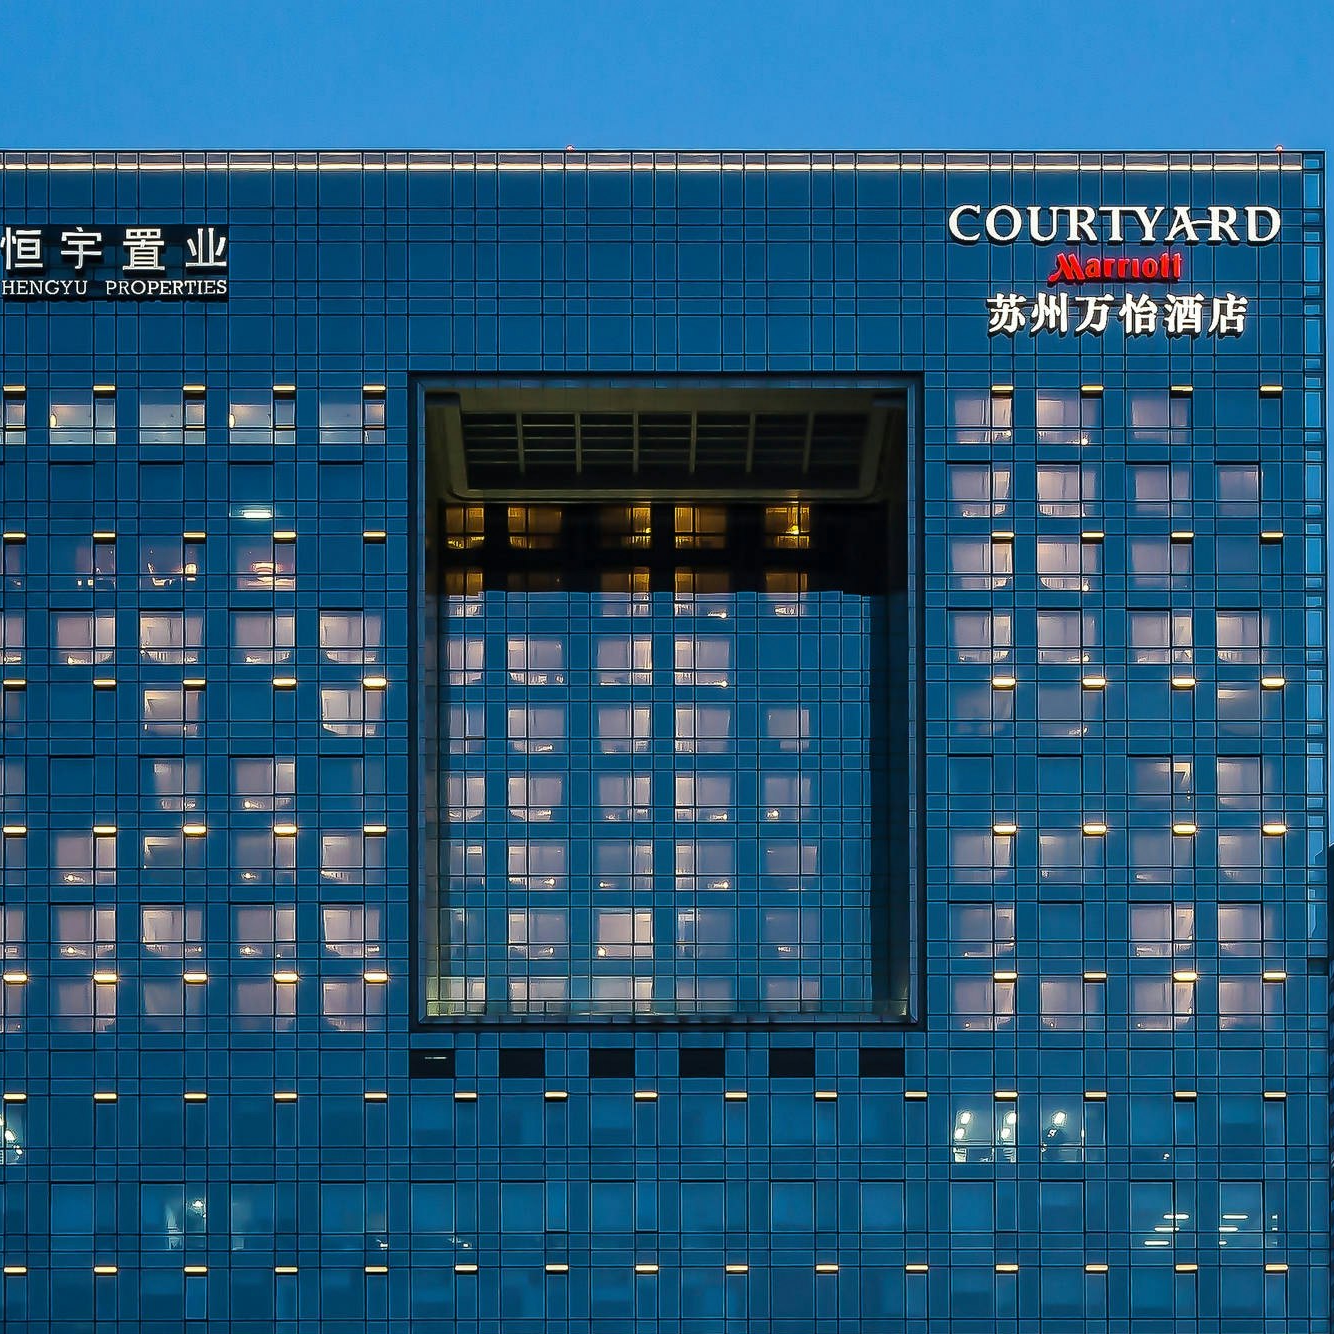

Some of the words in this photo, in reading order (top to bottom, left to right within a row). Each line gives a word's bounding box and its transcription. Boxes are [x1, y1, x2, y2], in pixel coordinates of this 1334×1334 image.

[948, 204, 1281, 243] COURTYARD
[0, 226, 227, 271] 恒宇置业
[1048, 251, 1183, 283] Marriott
[1, 279, 88, 296] HENGYU
[105, 279, 227, 296] PROPERTIES
[985, 292, 1249, 335] 苏州万怡酒店
